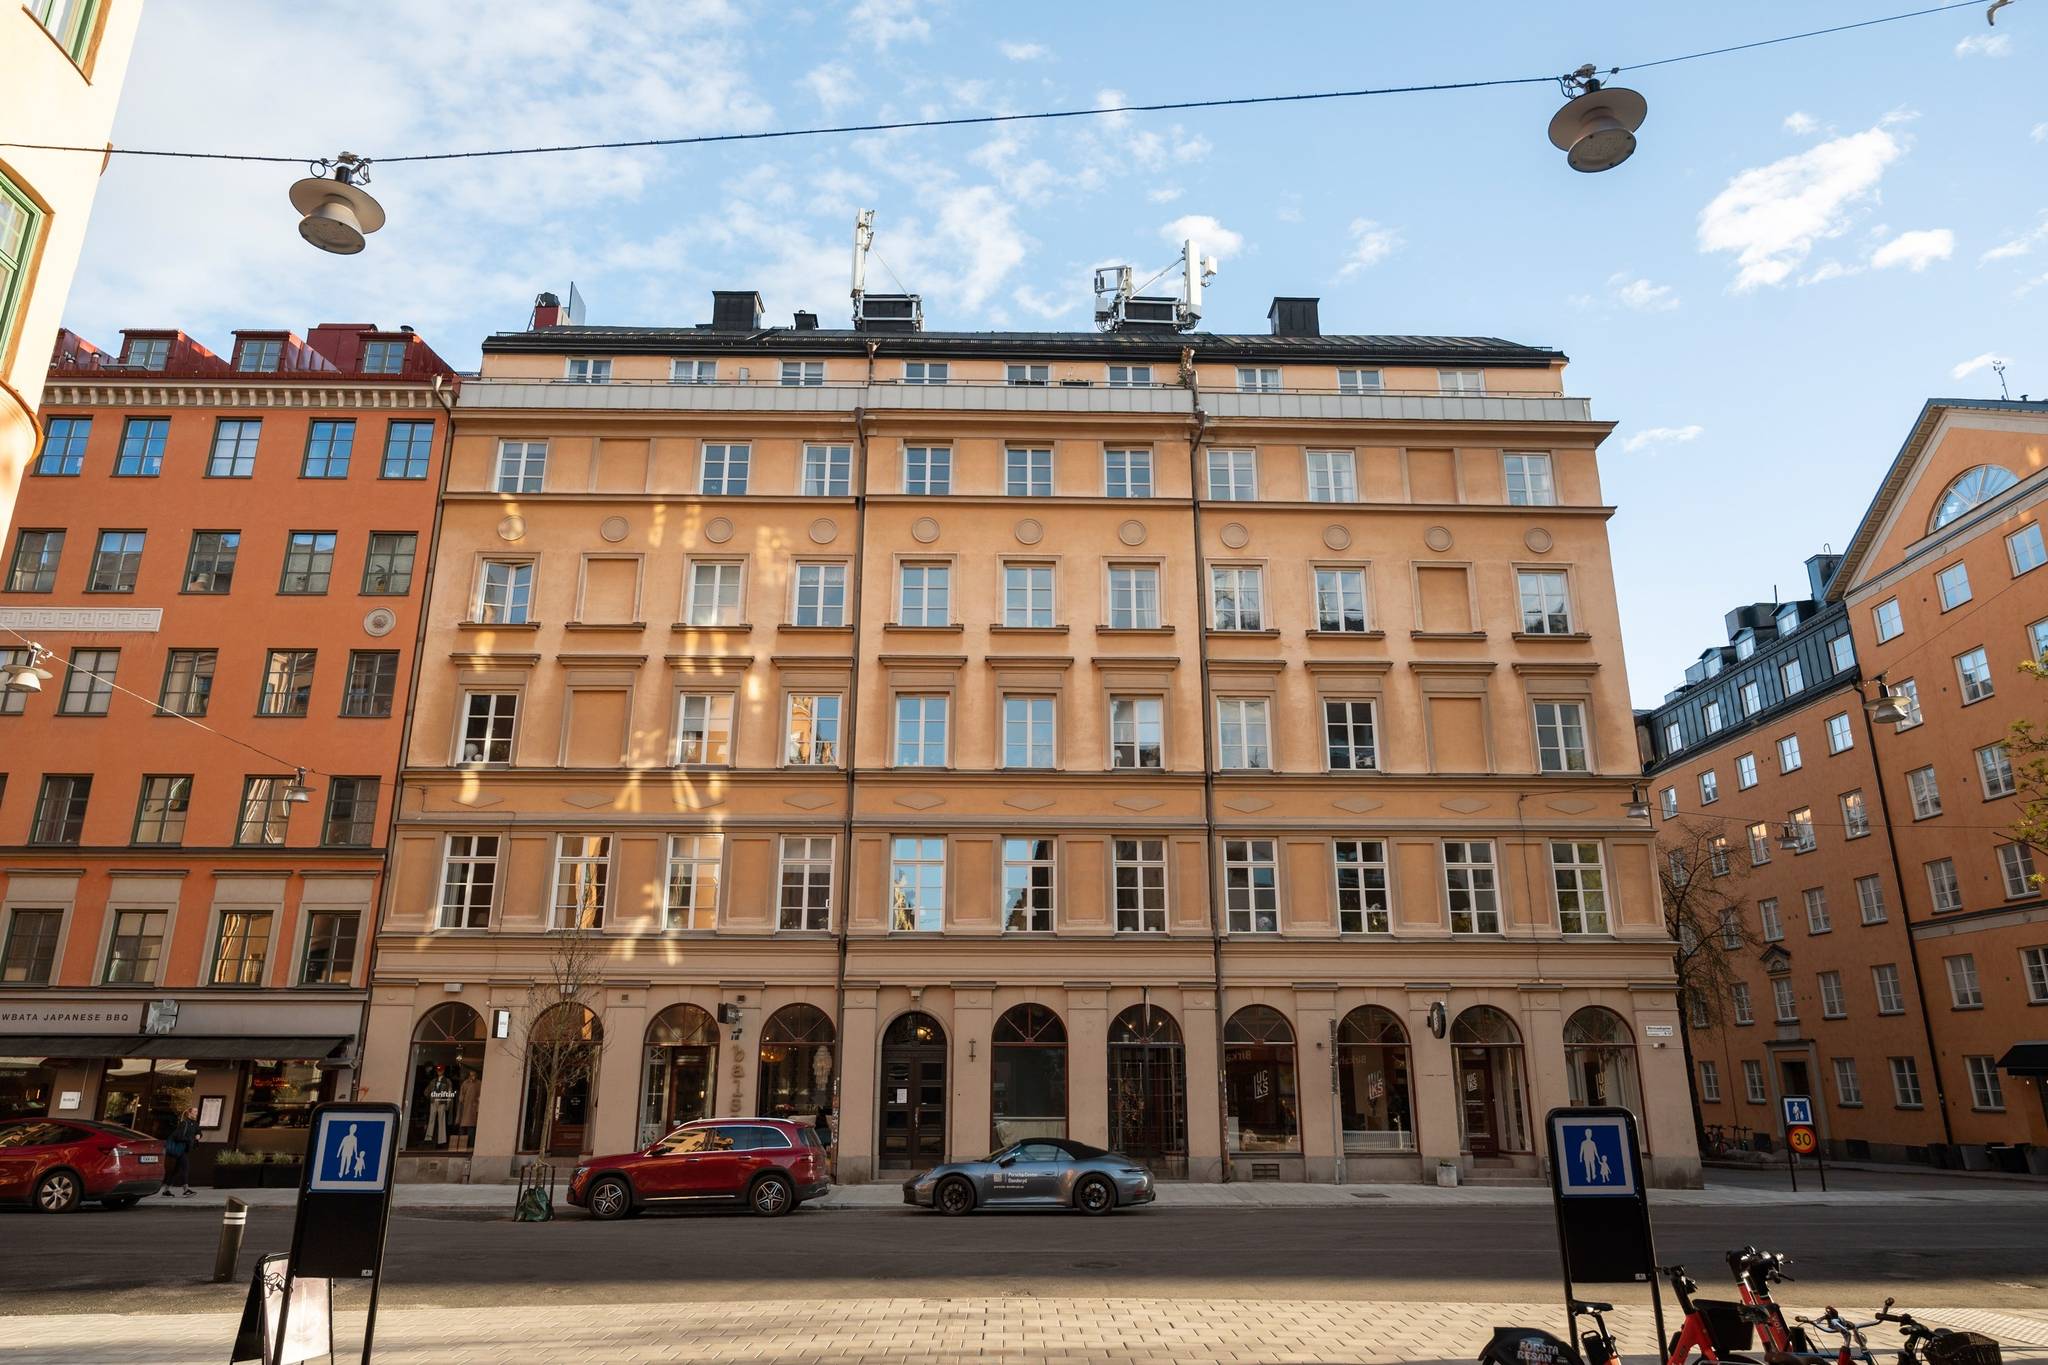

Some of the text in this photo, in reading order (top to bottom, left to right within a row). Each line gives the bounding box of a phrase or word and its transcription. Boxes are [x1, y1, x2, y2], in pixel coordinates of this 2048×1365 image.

[43, 1013, 102, 1021] JAPANESE
[106, 1013, 129, 1021] BBQ
[430, 1090, 457, 1098] thriftin'
[1794, 1132, 1812, 1146] 30
[1517, 1350, 1553, 1364] RESAN
